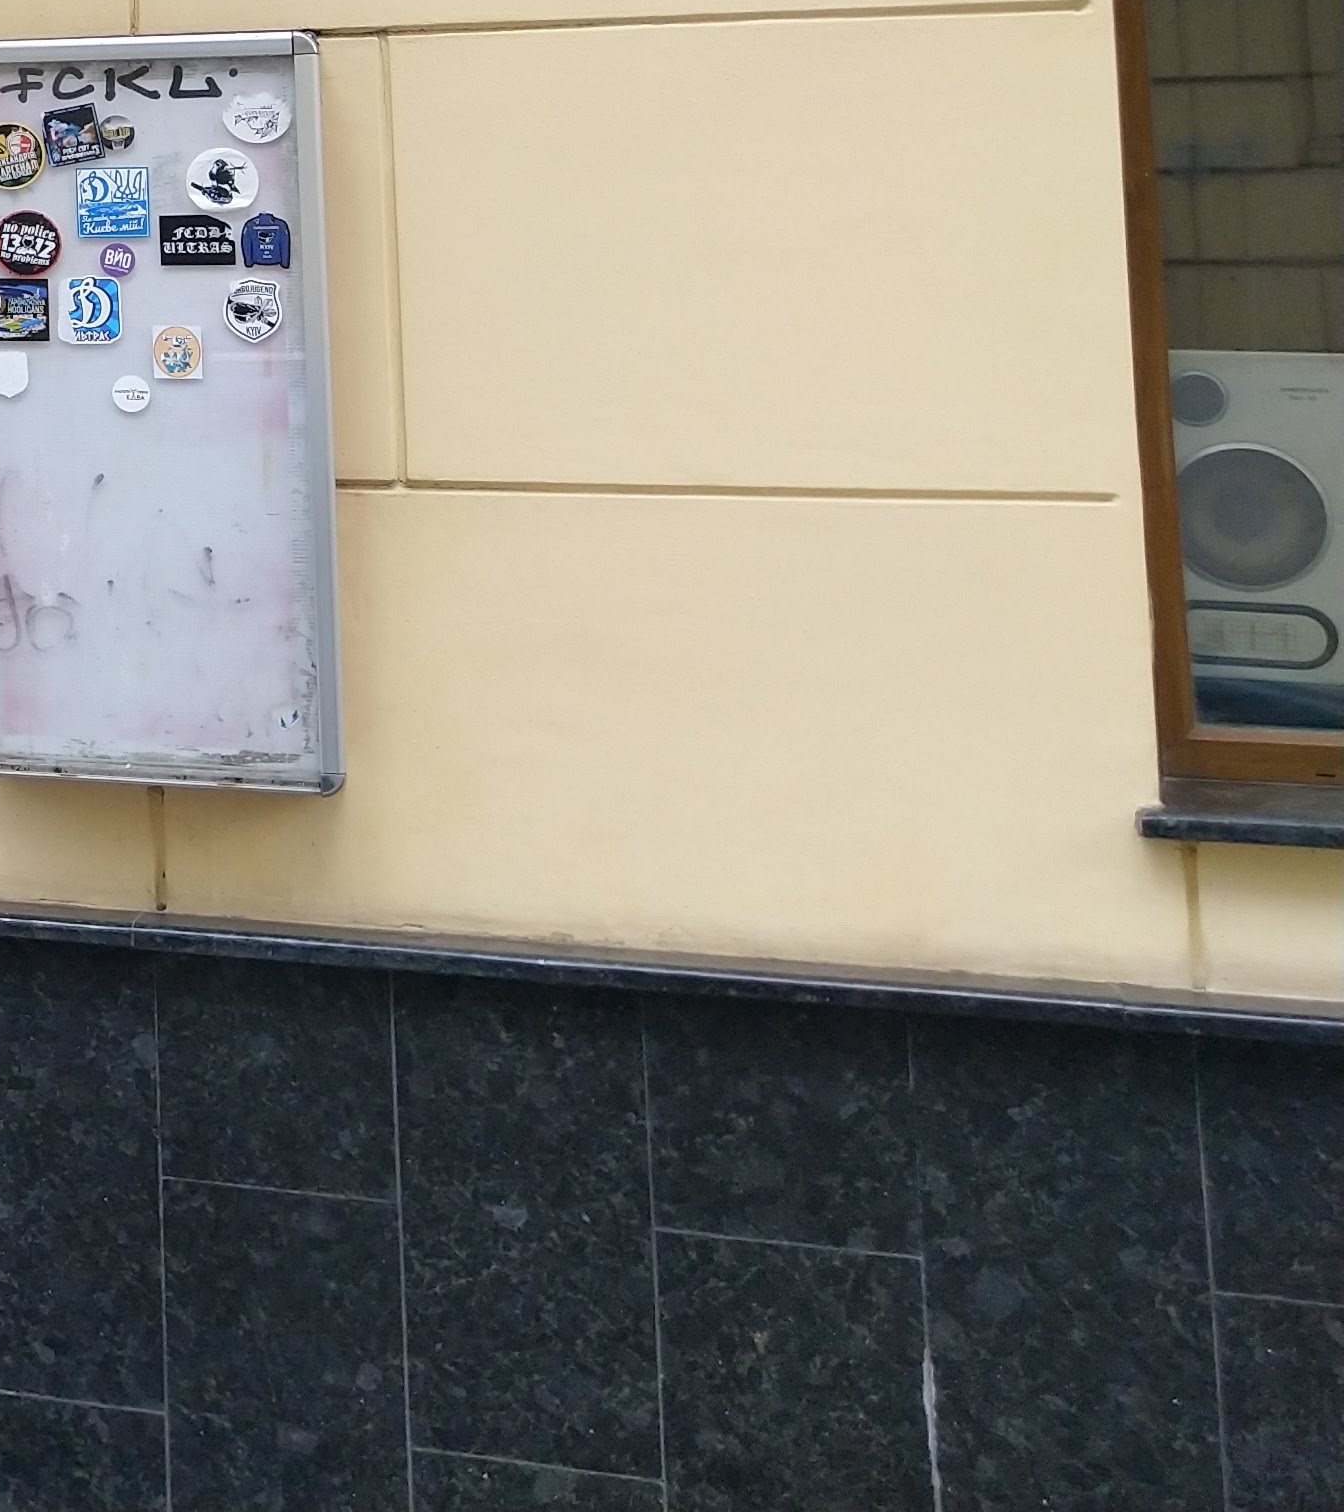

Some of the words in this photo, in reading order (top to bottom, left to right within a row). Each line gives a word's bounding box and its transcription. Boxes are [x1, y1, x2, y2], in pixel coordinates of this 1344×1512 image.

[3, 223, 20, 234] no
[20, 224, 56, 241] police
[162, 241, 233, 254] ULTRAS
[0, 251, 11, 260] no
[11, 253, 51, 266] problems
[104, 248, 132, 269] ВЙО
[245, 326, 262, 337] KYIV
